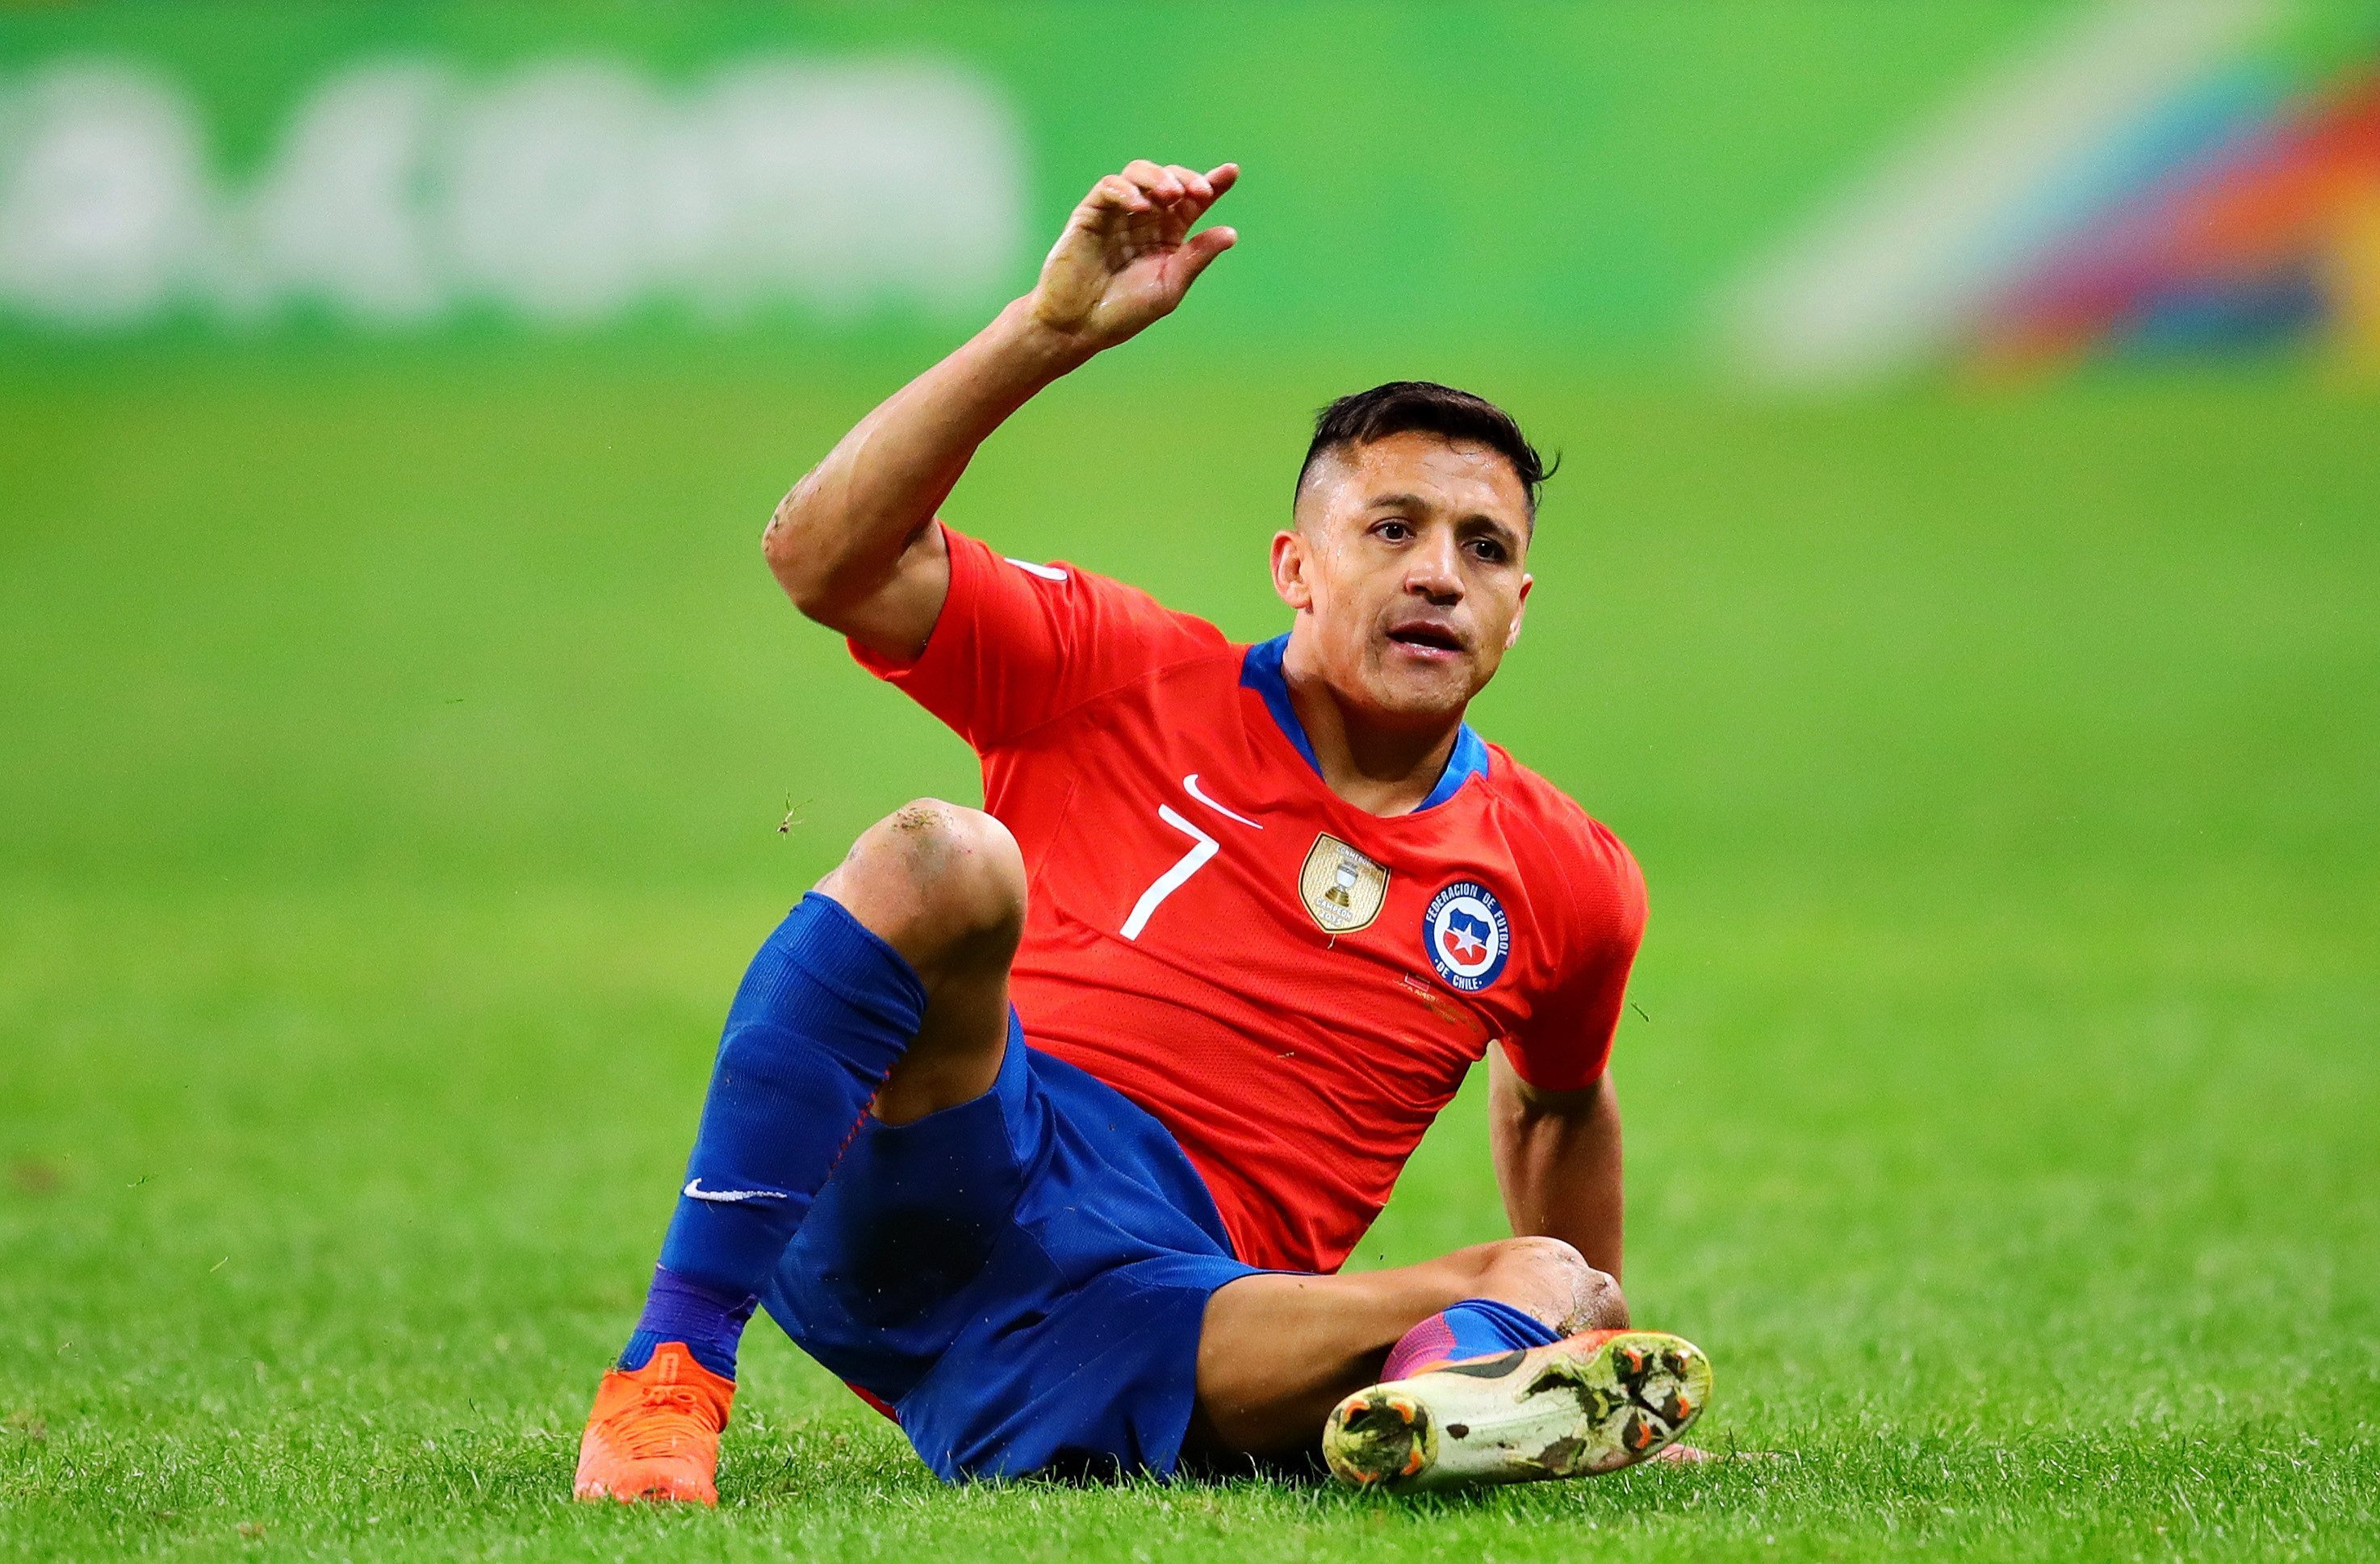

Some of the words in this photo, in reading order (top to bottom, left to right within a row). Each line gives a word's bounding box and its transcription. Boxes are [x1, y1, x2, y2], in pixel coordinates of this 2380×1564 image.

[1119, 803, 1220, 942] 7
[1316, 897, 1352, 919] CAMPEON
[1425, 883, 1478, 923] FEDERACION
[1483, 893, 1496, 910] DE
[1494, 910, 1509, 956] FUTBOL
